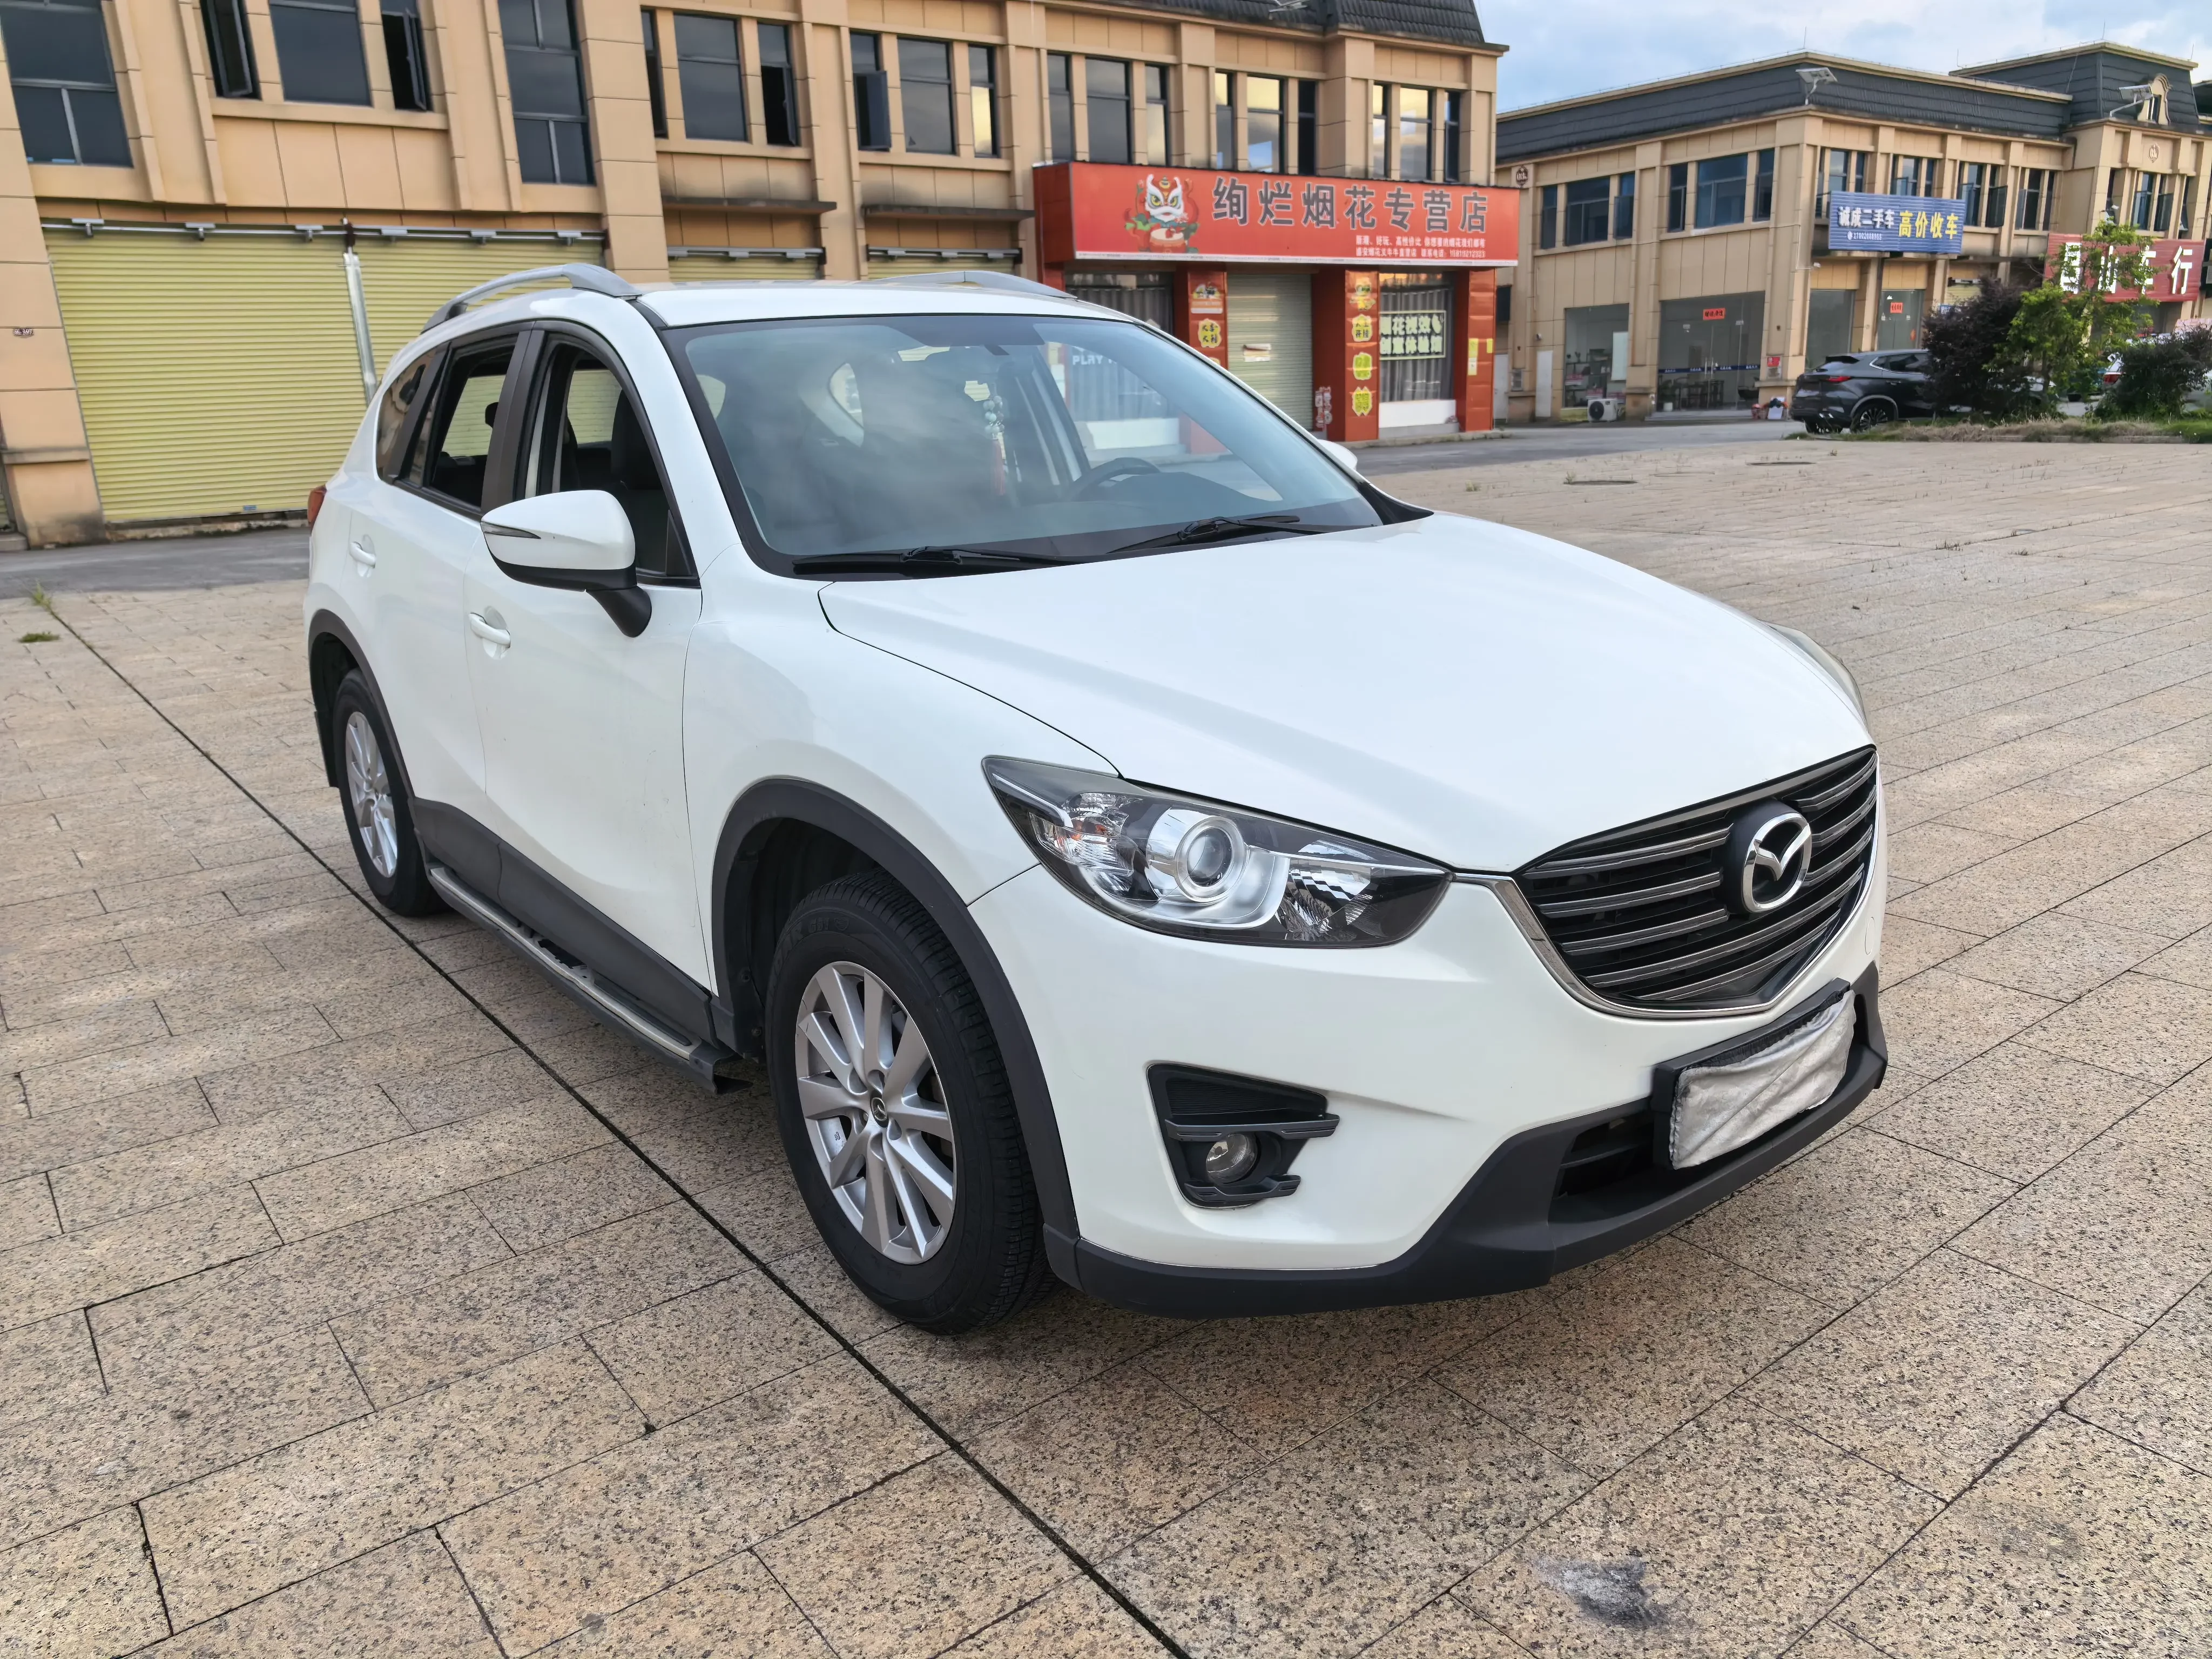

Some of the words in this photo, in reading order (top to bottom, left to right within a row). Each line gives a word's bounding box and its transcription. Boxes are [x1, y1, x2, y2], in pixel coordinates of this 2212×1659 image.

[1211, 176, 1487, 233] 绚烂烟花专营店
[1898, 210, 1959, 240] 高价收车
[1073, 354, 1103, 366] PLAY
